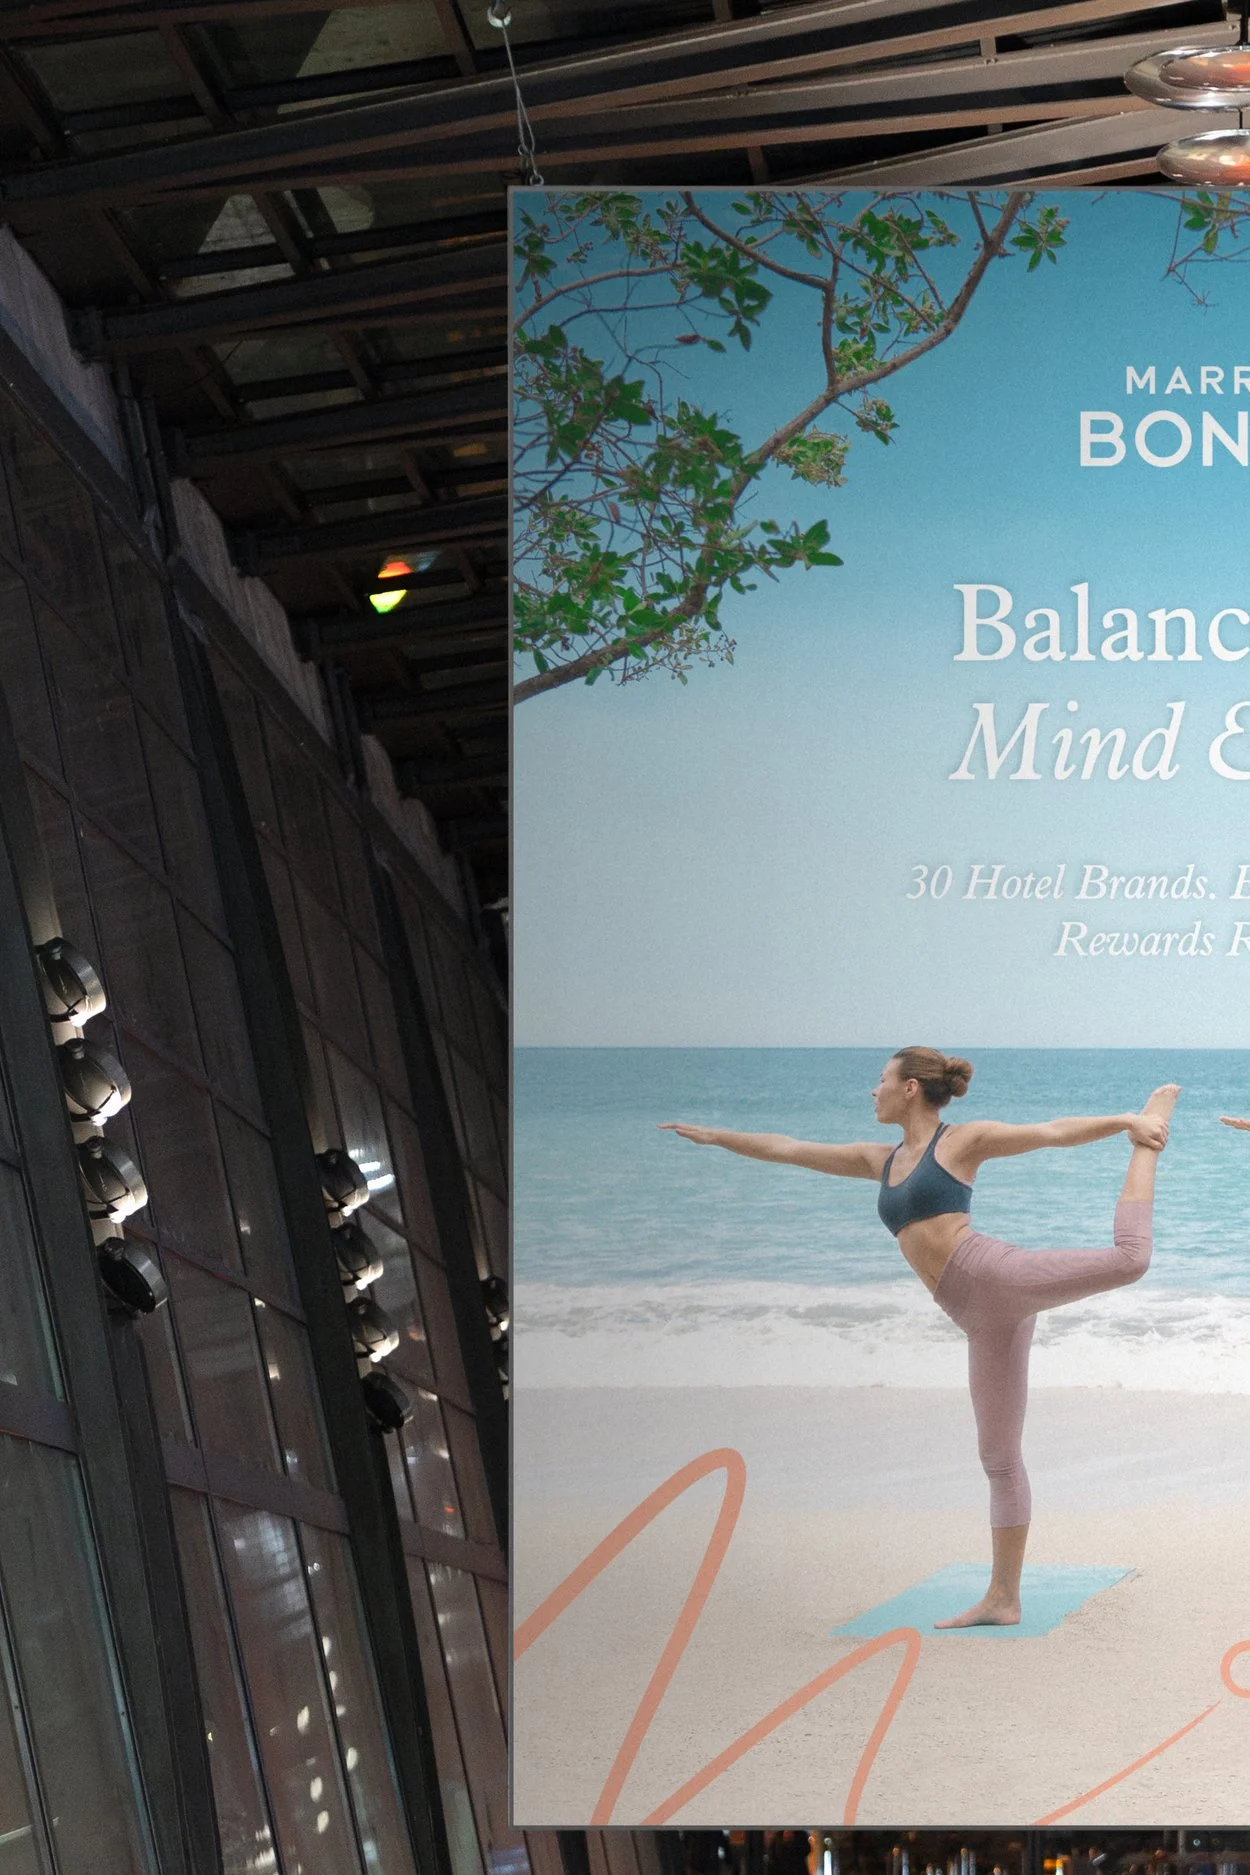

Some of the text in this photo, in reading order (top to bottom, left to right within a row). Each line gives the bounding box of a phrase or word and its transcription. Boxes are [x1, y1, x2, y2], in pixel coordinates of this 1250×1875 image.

[948, 700, 1187, 781] Mind
[905, 864, 954, 901] 30
[962, 863, 1065, 901] Hotel
[1075, 863, 1217, 901] Brands.
[1053, 920, 1216, 958] Rewards
